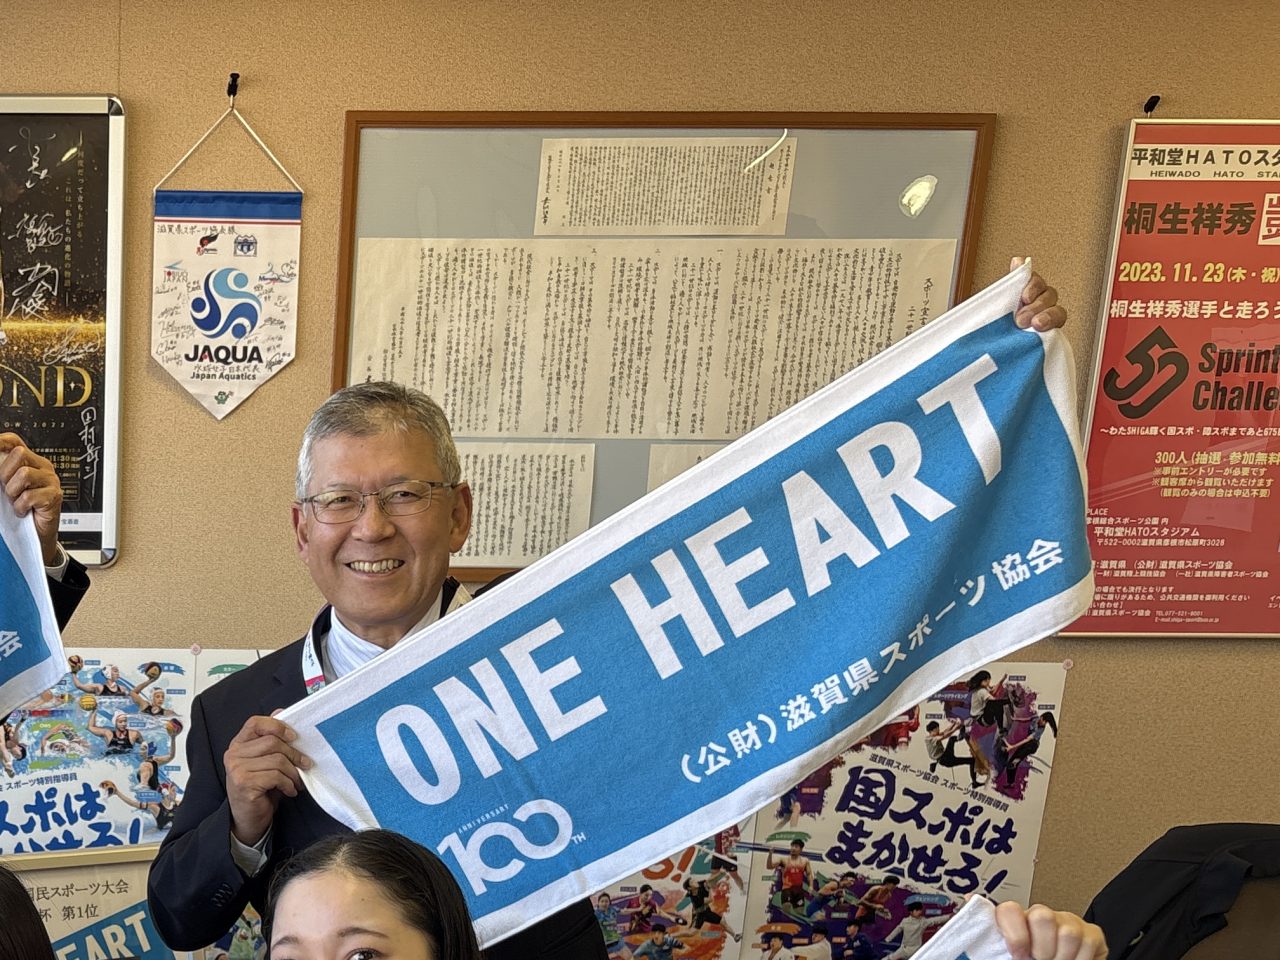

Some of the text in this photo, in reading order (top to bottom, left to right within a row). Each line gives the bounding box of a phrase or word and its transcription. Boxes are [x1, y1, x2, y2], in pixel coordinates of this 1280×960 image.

[1150, 170, 1201, 178] HEIWADO
[1213, 170, 1245, 178] HATO
[1123, 201, 1257, 236] 桐生祥秀
[184, 344, 263, 366] JAQUA
[190, 371, 257, 382] Japan Aquatics
[1192, 380, 1280, 412] Challe
[1093, 526, 1201, 538] 平和堂HATOスタジアム
[376, 618, 607, 805] ONE
[610, 353, 1004, 679] HEART
[681, 539, 1064, 782] (公財)滋賀県スポーツ協会
[6, 772, 78, 791] スポーツ特別指導員
[869, 752, 1009, 813] 滋賀県スポーツ協会 スポーツ特別指導員
[458, 803, 510, 834] ANNIVERSARY
[834, 765, 1018, 855] 国スポは
[826, 820, 1008, 894] まかせろ!
[62, 904, 100, 921] 第1位
